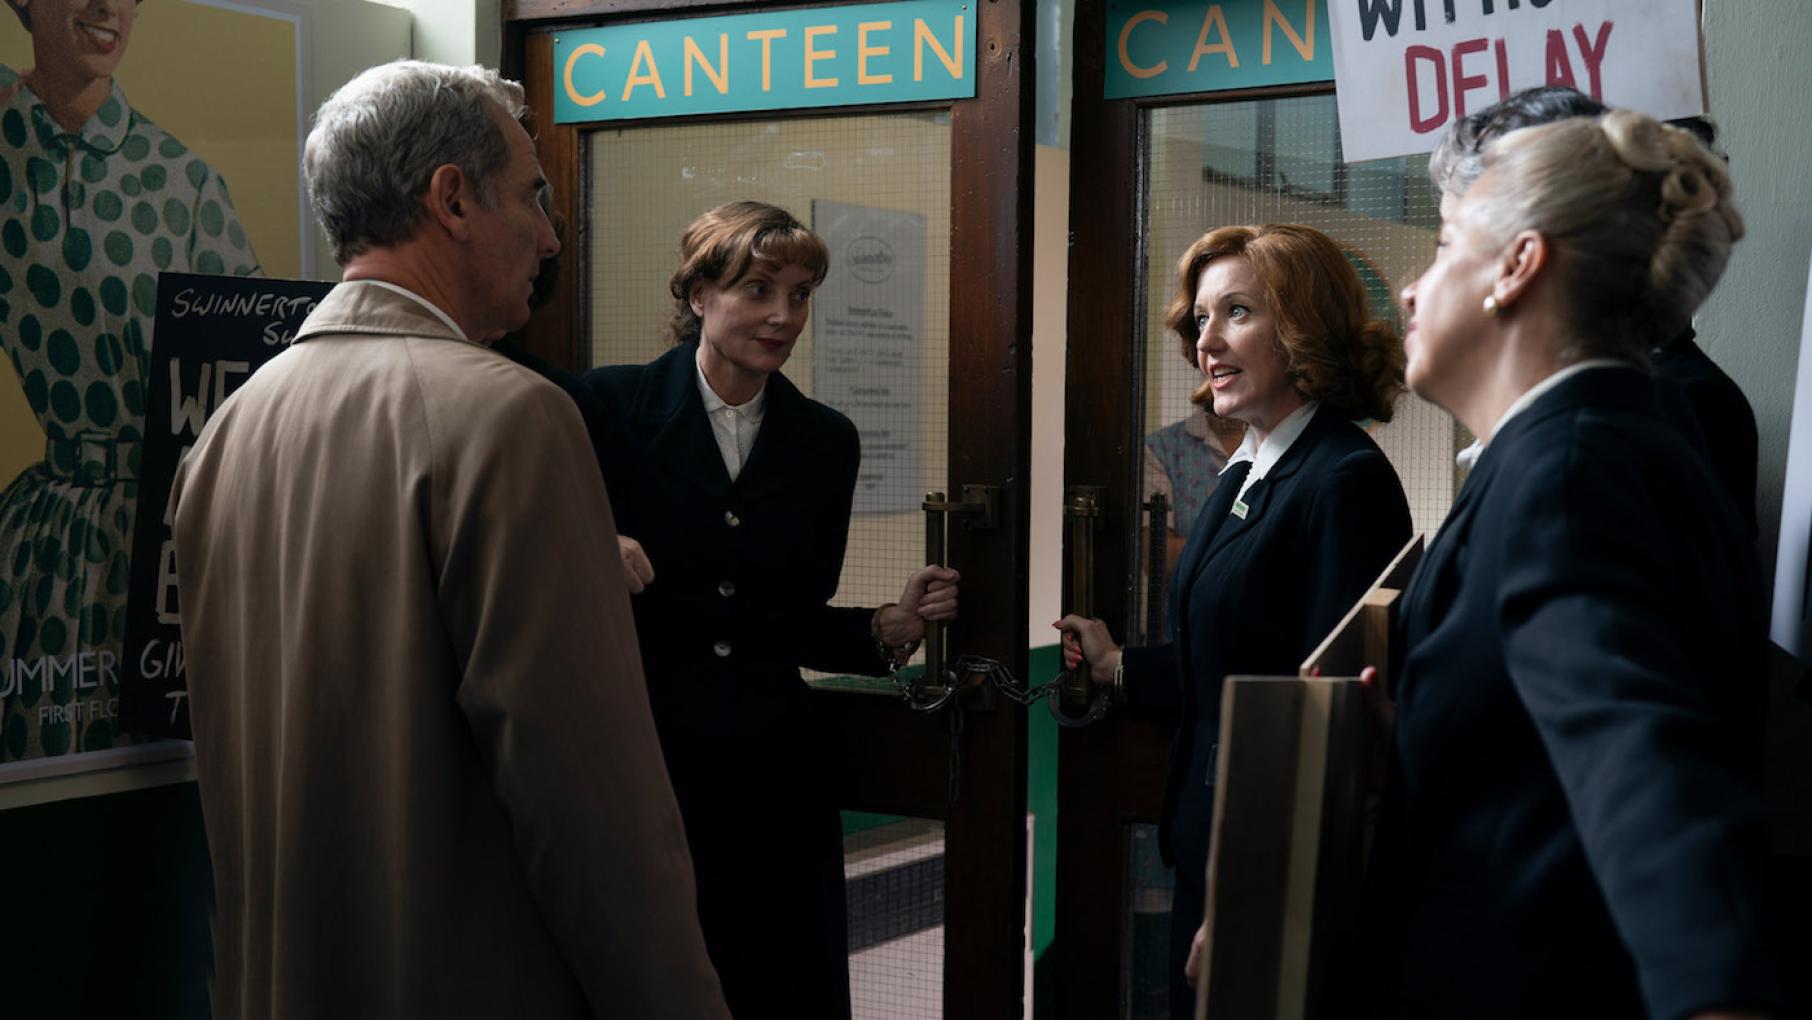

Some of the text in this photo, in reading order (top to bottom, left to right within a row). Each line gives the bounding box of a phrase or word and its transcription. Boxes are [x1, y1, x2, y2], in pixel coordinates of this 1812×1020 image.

[563, 15, 964, 106] CANTEEN
[1117, 0, 1316, 79] CAN
[38, 702, 85, 726] FIRST
